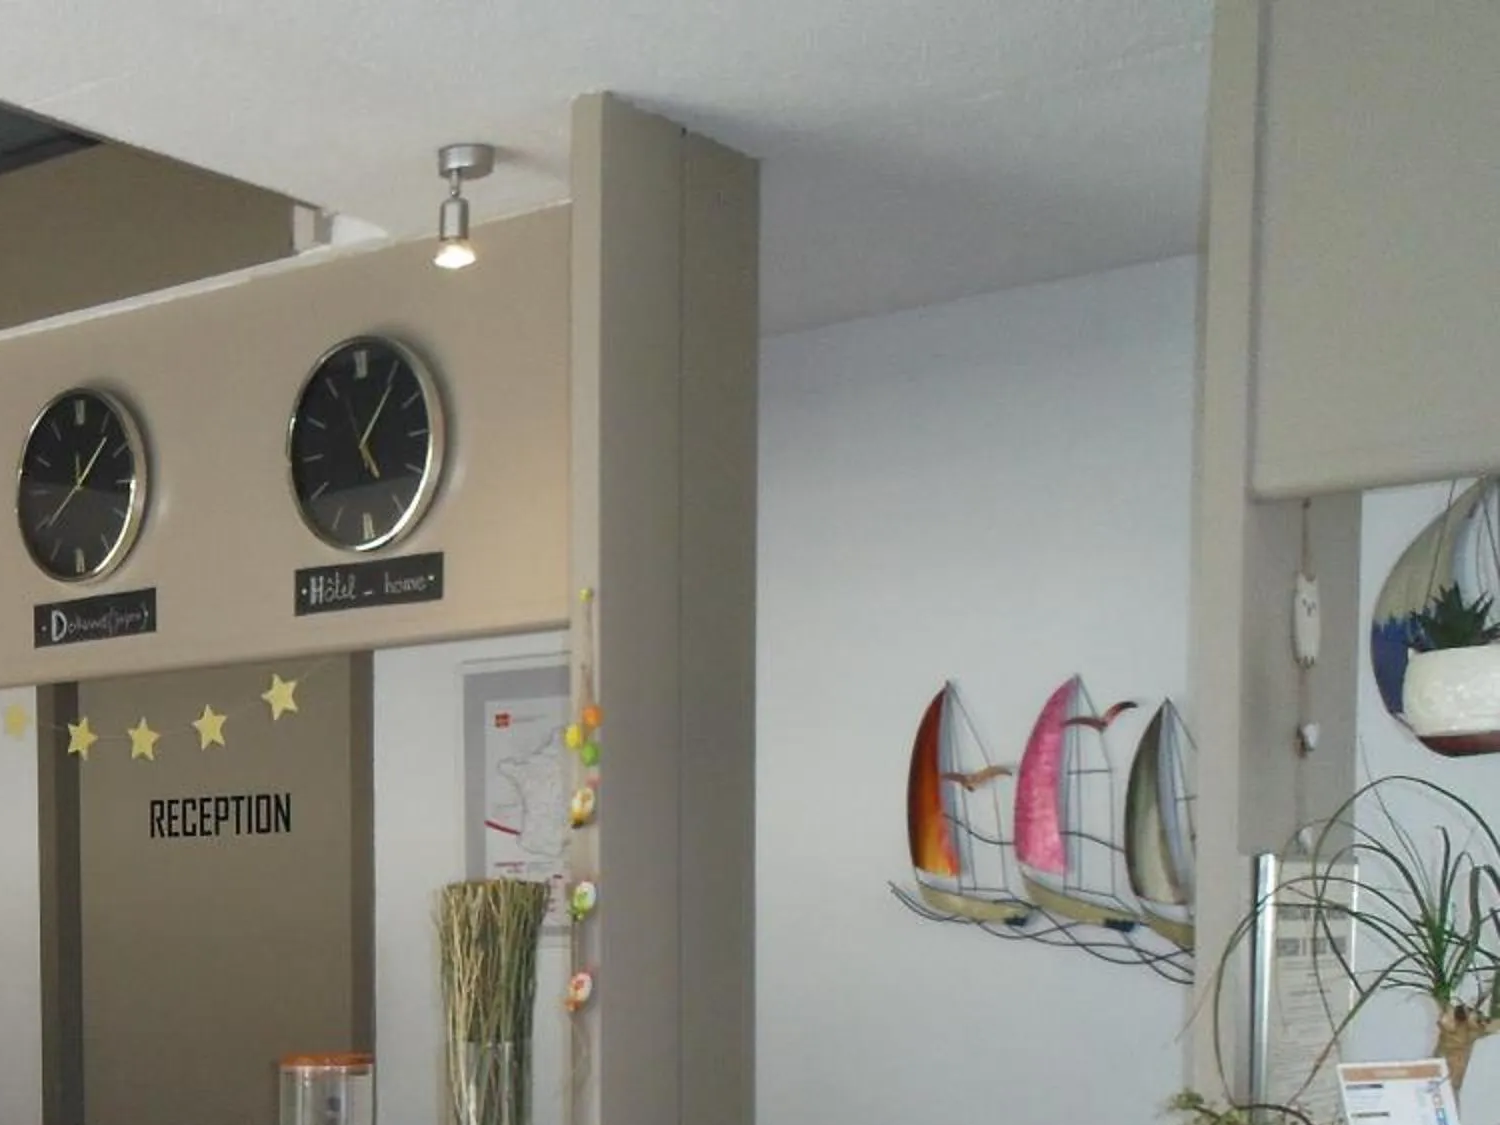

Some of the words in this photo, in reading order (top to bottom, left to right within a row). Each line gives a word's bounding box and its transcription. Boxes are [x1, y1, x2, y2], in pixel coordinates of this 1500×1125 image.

[310, 572, 357, 605] Hôtel
[385, 571, 427, 593] home
[150, 793, 291, 838] RECEPTION
